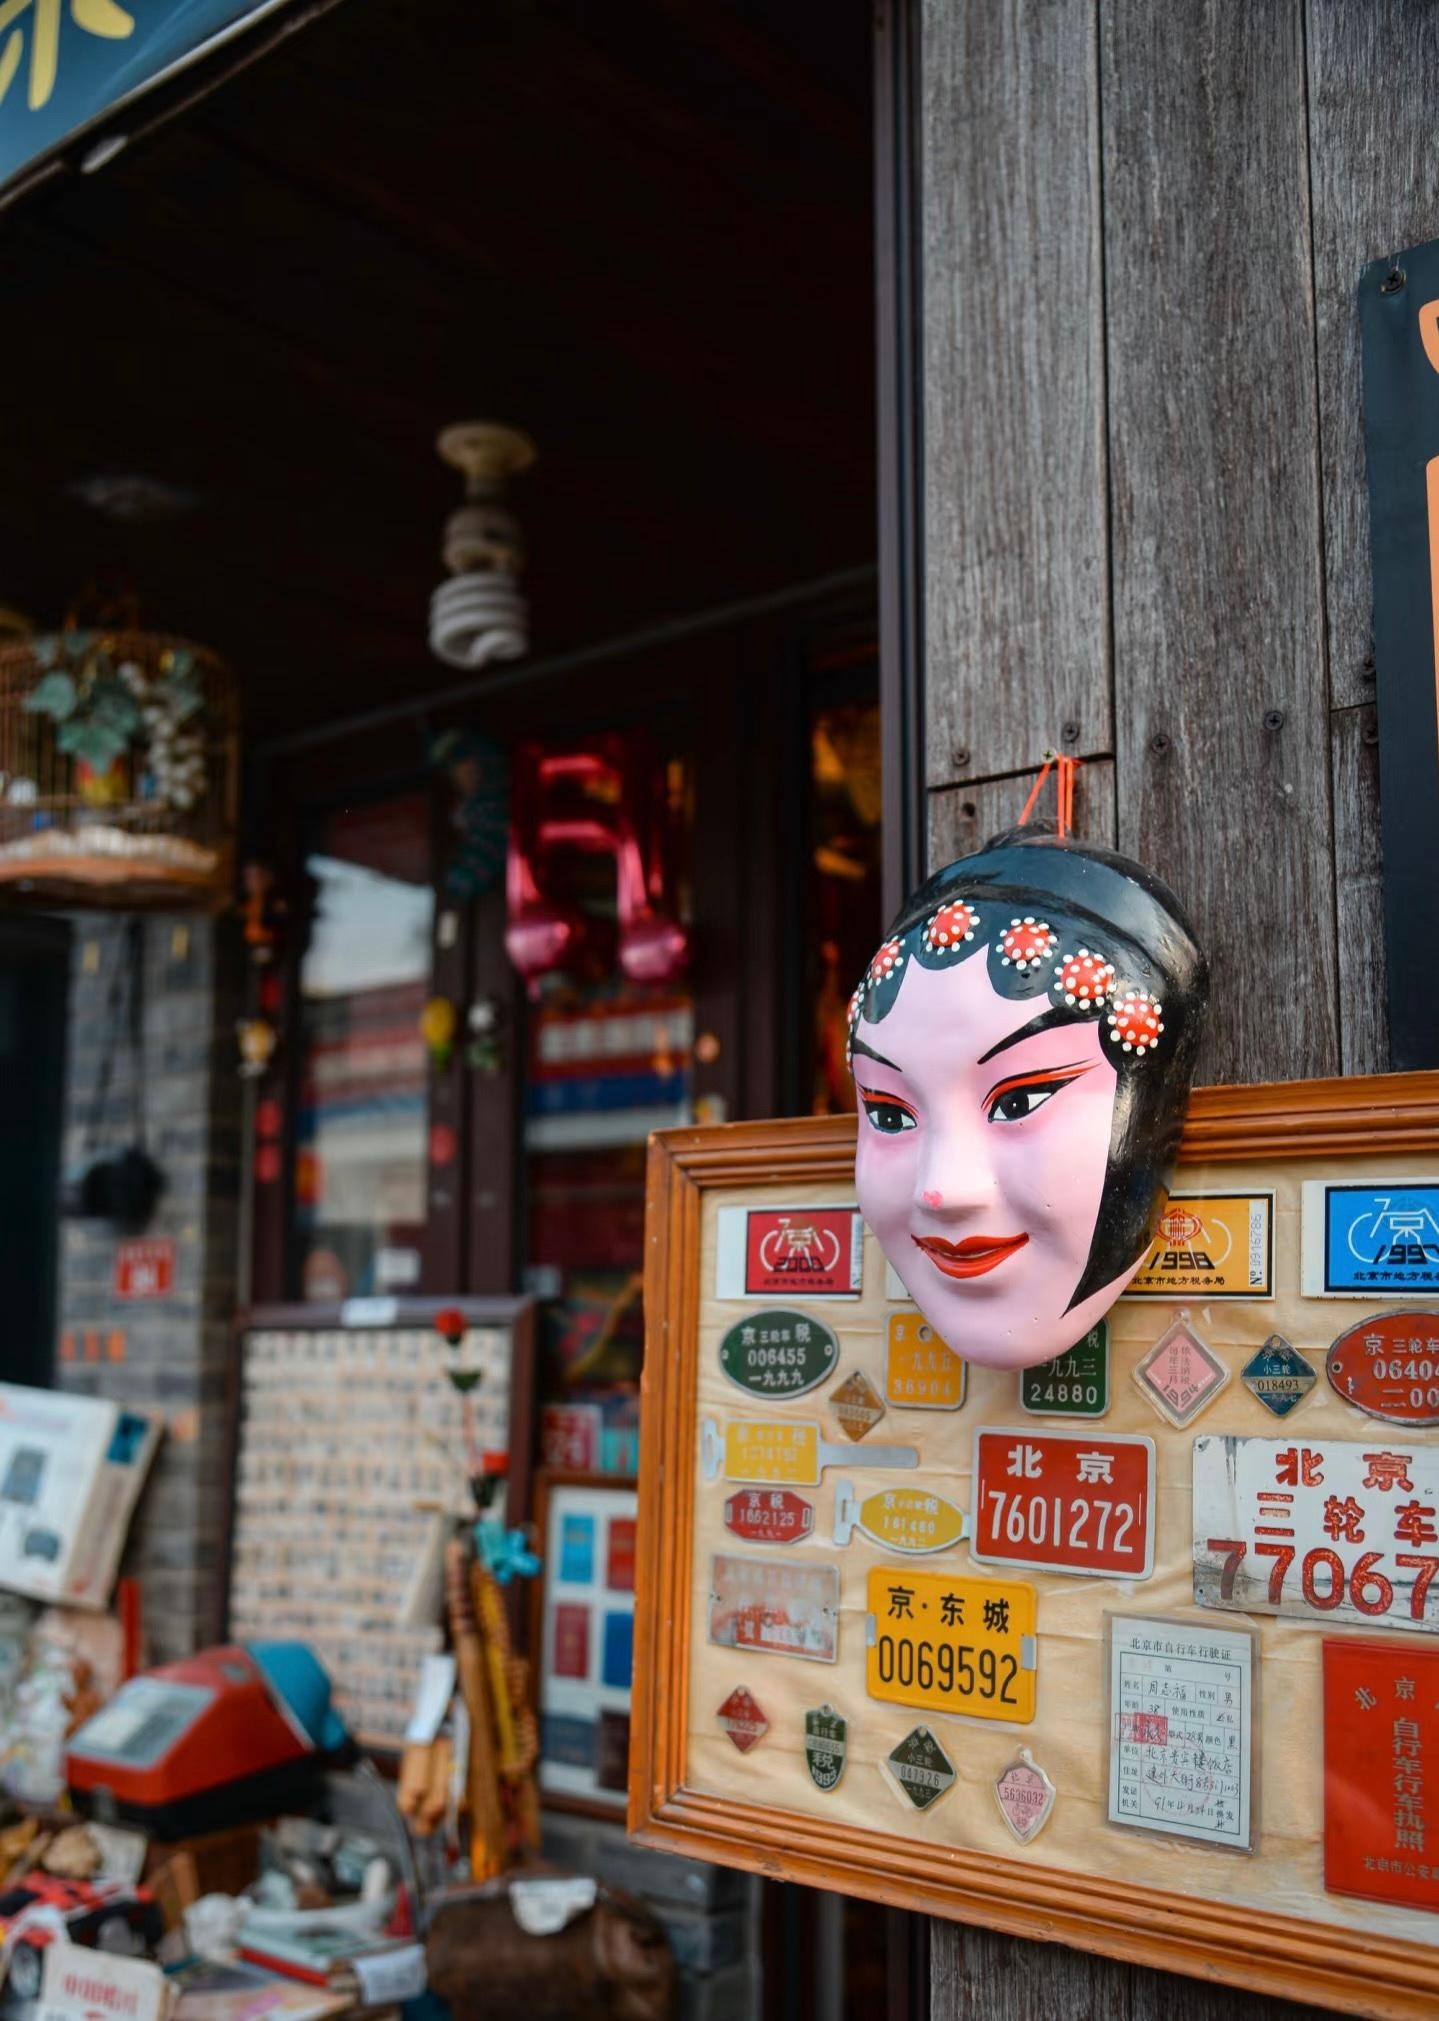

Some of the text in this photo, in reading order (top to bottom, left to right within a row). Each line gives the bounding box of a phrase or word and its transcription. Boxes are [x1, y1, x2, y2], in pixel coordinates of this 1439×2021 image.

[1149, 1251, 1215, 1270] 1998
[747, 1346, 806, 1367] 006455
[1030, 1382, 1098, 1405] 24880
[1257, 1379, 1299, 1392] 018493
[1006, 1444, 1115, 1484] 北京
[1275, 1447, 1415, 1493] 北京
[988, 1489, 1134, 1553] 7601272
[1254, 1492, 1439, 1547] 三轮车
[1206, 1538, 1439, 1621] 77067
[878, 1634, 1018, 1705] 0069592
[1130, 1638, 1232, 1661] 北京市自行车行驶证
